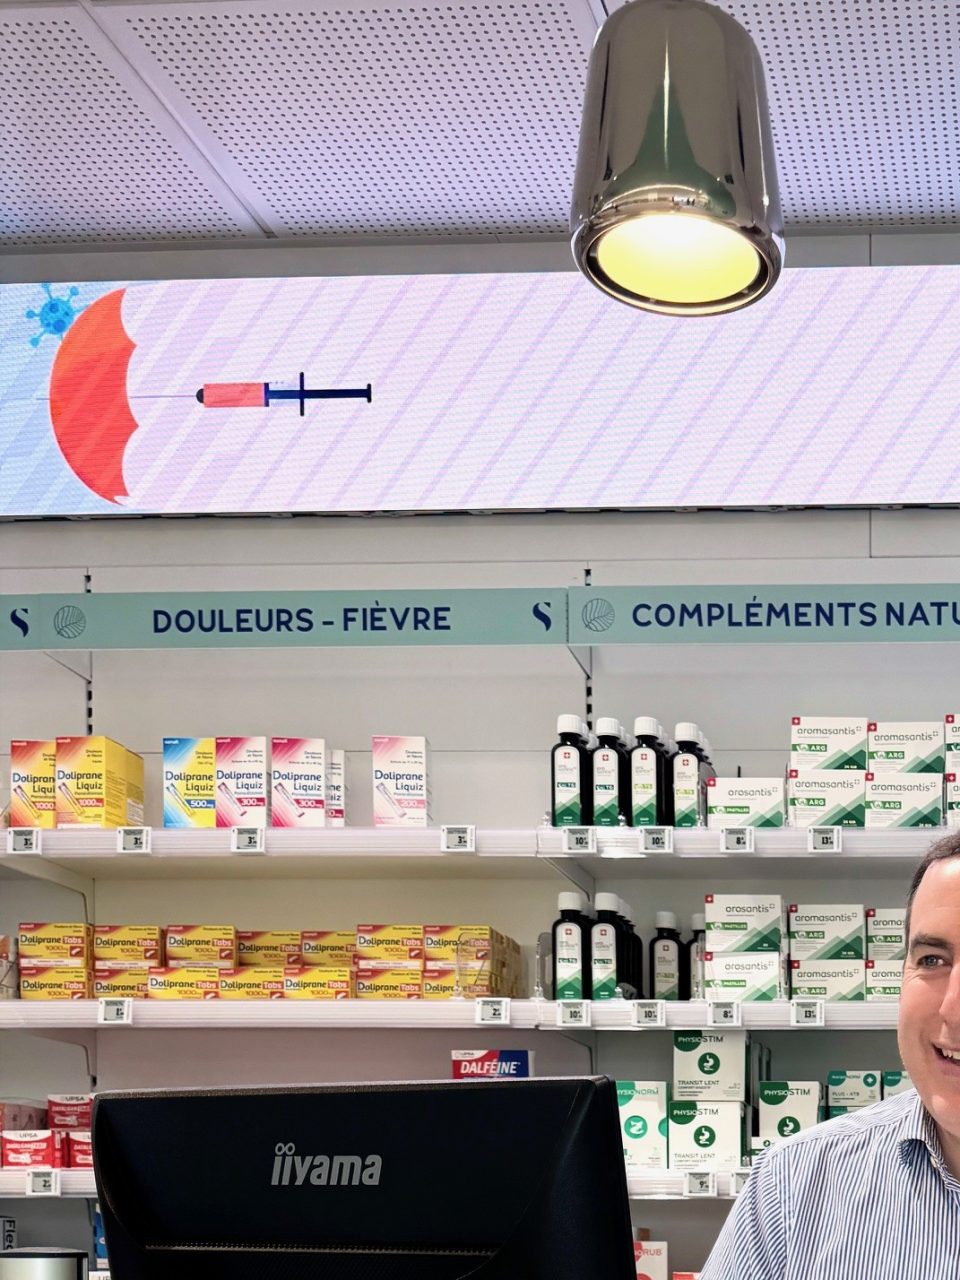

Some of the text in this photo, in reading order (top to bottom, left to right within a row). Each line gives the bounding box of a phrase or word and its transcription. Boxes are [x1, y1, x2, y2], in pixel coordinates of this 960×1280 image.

[632, 595, 877, 627] COMPLÉMENTS
[152, 600, 452, 634] DOULEURS FIÈVRE
[797, 727, 857, 737] aromasantis
[874, 733, 933, 743] aromasantis
[810, 744, 826, 752] ARG
[12, 772, 56, 784] Dolipran
[57, 770, 103, 781] Doliprane
[165, 771, 214, 783] Doliprane
[216, 770, 263, 781] Doliprane
[273, 770, 322, 782] Doliprane
[374, 770, 424, 781] Doliprane
[76, 782, 103, 791] Liquiz
[186, 783, 214, 793] Liquiz
[236, 781, 263, 791] Liquiz
[293, 782, 322, 792] Liquiz
[395, 782, 424, 792] Liquiz
[795, 780, 856, 790] aromasantis
[871, 783, 931, 793] aromasantis
[809, 798, 825, 807] ARG
[884, 801, 900, 809] ARG
[725, 904, 770, 913] orosantis
[795, 914, 852, 922] aromasantis
[20, 934, 82, 946] Doliprane Tabs
[95, 937, 158, 947] Doliprane Tabs
[169, 937, 233, 948] Doliprane Tabs
[359, 936, 421, 947] Doliprane Tabs
[238, 943, 279, 953] Doliprane
[304, 943, 345, 953] Doliprane
[725, 962, 769, 970] orosantis
[797, 969, 855, 978] aromasantis
[22, 981, 84, 991] Doliprane Tabs
[95, 982, 136, 992] Doliprane
[150, 978, 217, 989] Doliprane Tabs
[220, 980, 283, 990] Doliprane Tabs
[285, 978, 348, 989] Doliprane Tabs
[358, 982, 420, 992] Doliprane Tabs
[460, 1059, 518, 1075] DALFÉINE
[270, 1142, 383, 1186] iiyama
